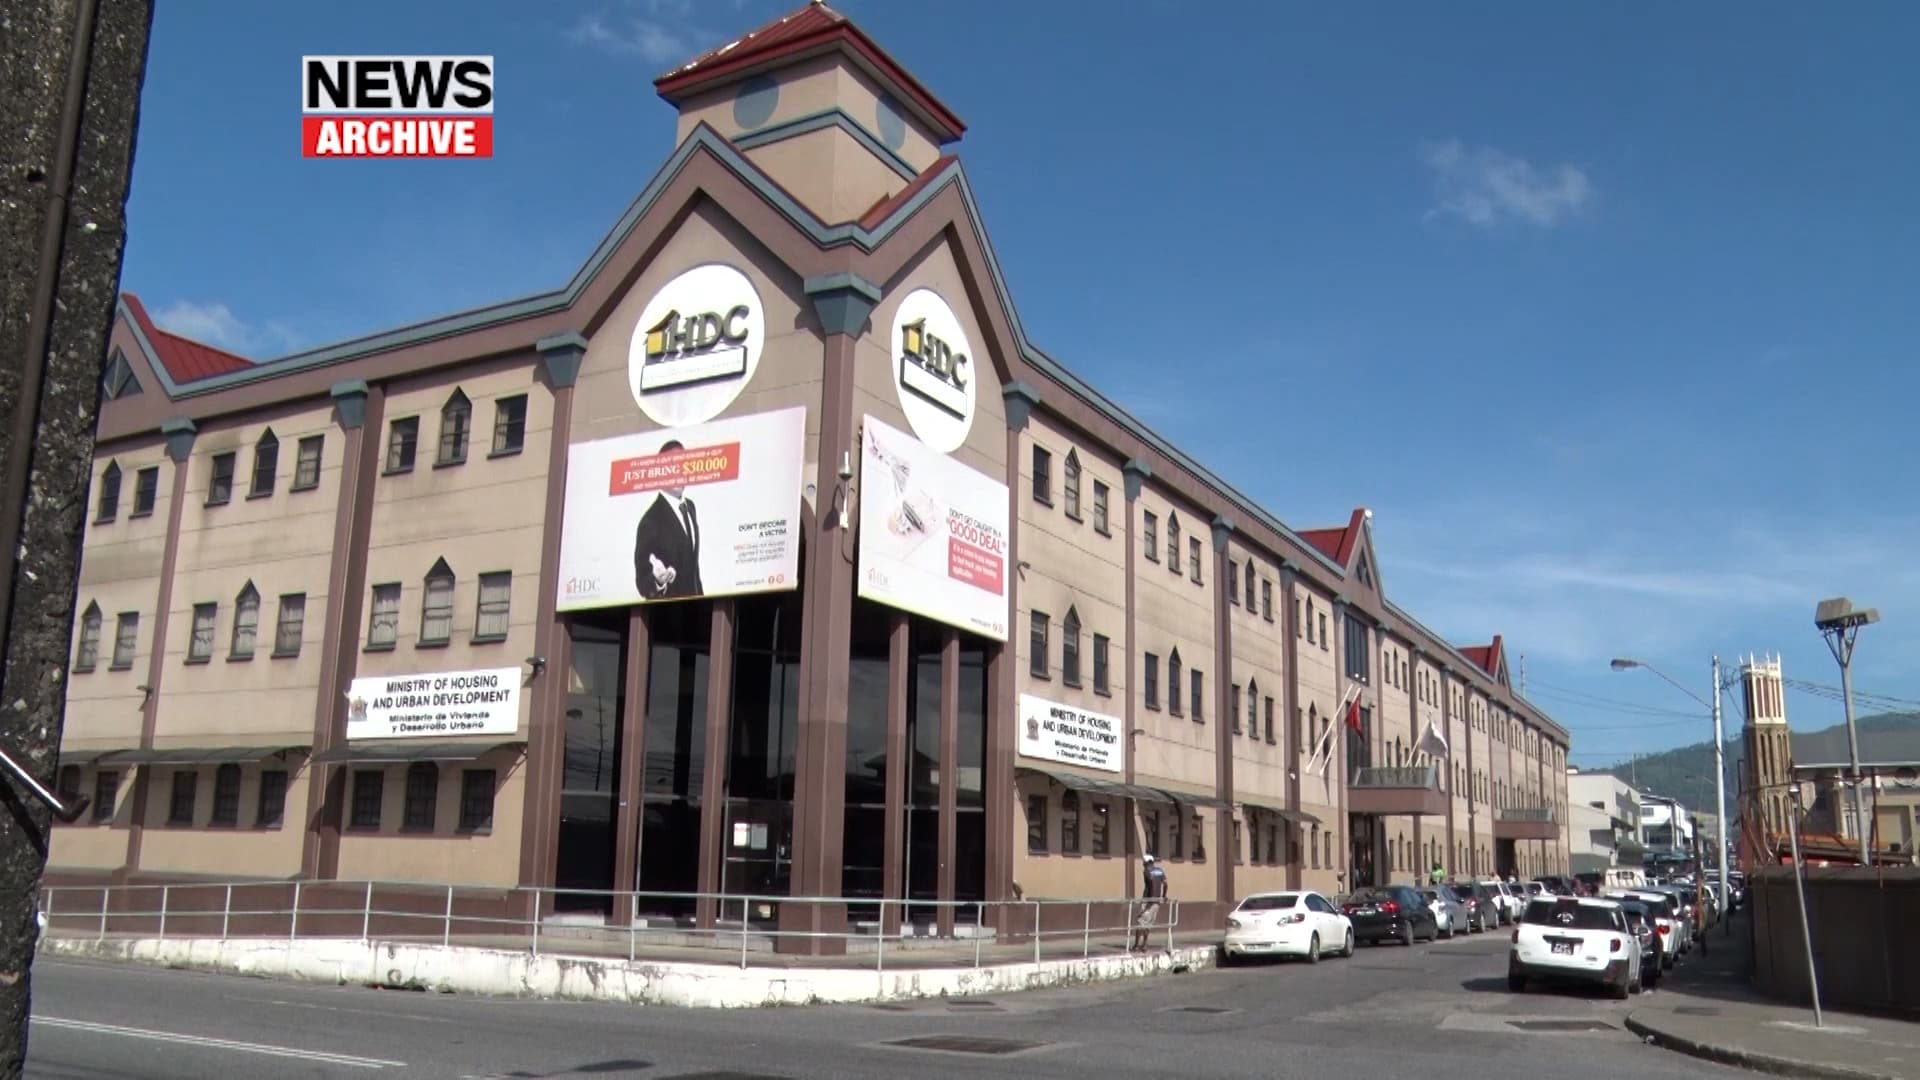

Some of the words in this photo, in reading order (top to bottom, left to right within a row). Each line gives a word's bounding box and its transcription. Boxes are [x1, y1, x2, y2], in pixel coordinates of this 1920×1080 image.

[665, 304, 749, 353] HDC
[918, 318, 968, 387] HDC
[622, 469, 647, 484] JUST
[648, 464, 680, 478] BRING
[682, 456, 727, 475] $30,000
[386, 679, 431, 693] MINISTRY
[434, 678, 449, 690] OF
[451, 675, 498, 689] HOUSING
[373, 697, 393, 709] AND
[395, 695, 430, 708] URBAN
[433, 689, 511, 706] DEVELOPMENT
[389, 713, 433, 723] Ministerio
[450, 711, 490, 720] Vivienda
[400, 722, 447, 732] Desarrollo
[450, 720, 484, 730] Urbano
[1050, 707, 1076, 722] MINISTRY
[1078, 713, 1086, 724] OF
[1087, 717, 1111, 732] HOUSING
[1043, 719, 1056, 732] AND
[1056, 723, 1077, 737] URBAN
[1078, 727, 1117, 744] DEVELOPMENT
